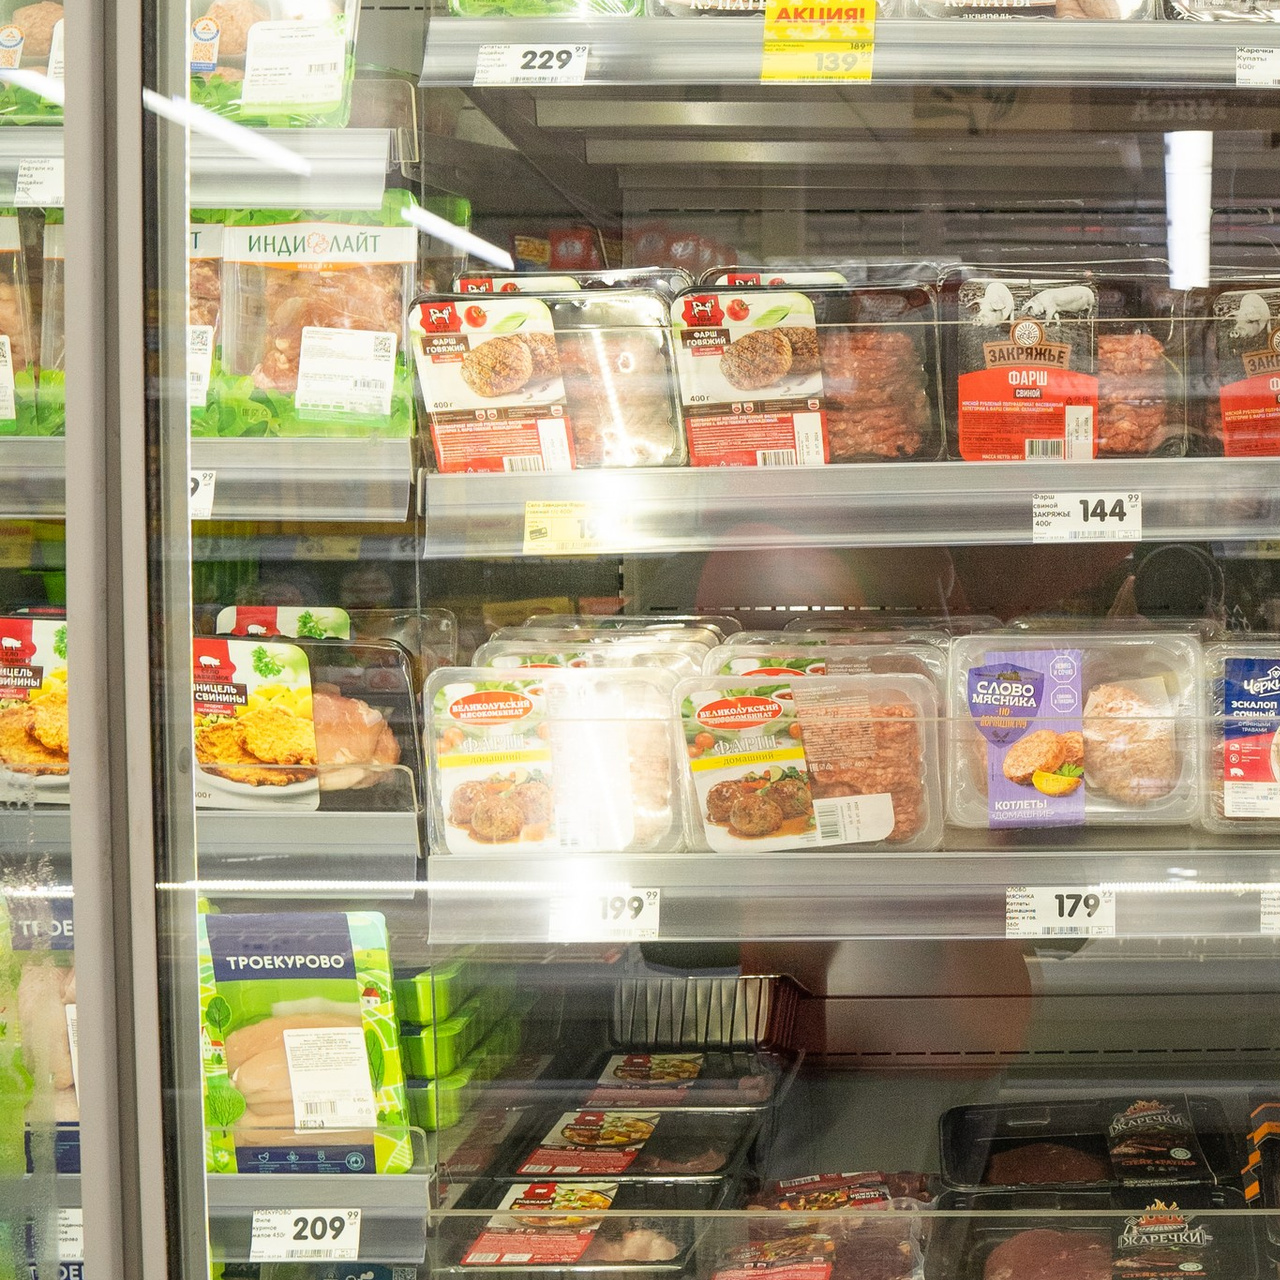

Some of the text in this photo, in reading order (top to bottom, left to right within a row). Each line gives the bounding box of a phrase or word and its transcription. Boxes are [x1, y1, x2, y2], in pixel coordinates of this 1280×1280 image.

[775, 7, 866, 26] АКЦИЯ!
[520, 46, 587, 70] 229 99
[1237, 47, 1274, 55] Жаречки
[815, 51, 858, 72] 139
[432, 338, 456, 346] ФАРШ
[687, 337, 726, 346] ГОВЯЖИЙ
[694, 331, 718, 339] ФАРШ
[426, 344, 466, 354] ГОВЯЖИЙ
[988, 341, 1066, 364] ЗАКРЯЖЬЕ
[1009, 370, 1048, 387] ФАРШ
[1015, 388, 1041, 398] СВИНОЙ
[1033, 493, 1055, 501] Фарш
[1033, 510, 1071, 518] ЗАКРЯЖЬЕ
[1080, 493, 1140, 522] 144 99
[1035, 520, 1052, 528] 400г
[977, 681, 1035, 696] СЛОВО
[195, 693, 246, 705] СВИНИНЫ
[452, 699, 530, 713] ВЕЛИКОЛУКСКИЙ
[972, 693, 1037, 708] МЯСНИКА
[1231, 700, 1278, 709] ЭСКАЛОП
[700, 702, 780, 719] ВЕЛИКОЛУКСКИЙ
[714, 734, 778, 754] ФАРШ
[723, 753, 775, 766] домашний
[995, 799, 1048, 811] КОТЛЕТЫ
[599, 891, 658, 920] 199 99
[1054, 893, 1100, 918] 179
[226, 954, 344, 970] ТРОЕКУРОВО
[1113, 1115, 1182, 1133] ЖАРЕЧКИ
[293, 1210, 359, 1240] 209 99
[1121, 1231, 1202, 1246] ЖАРЕЧКИ
